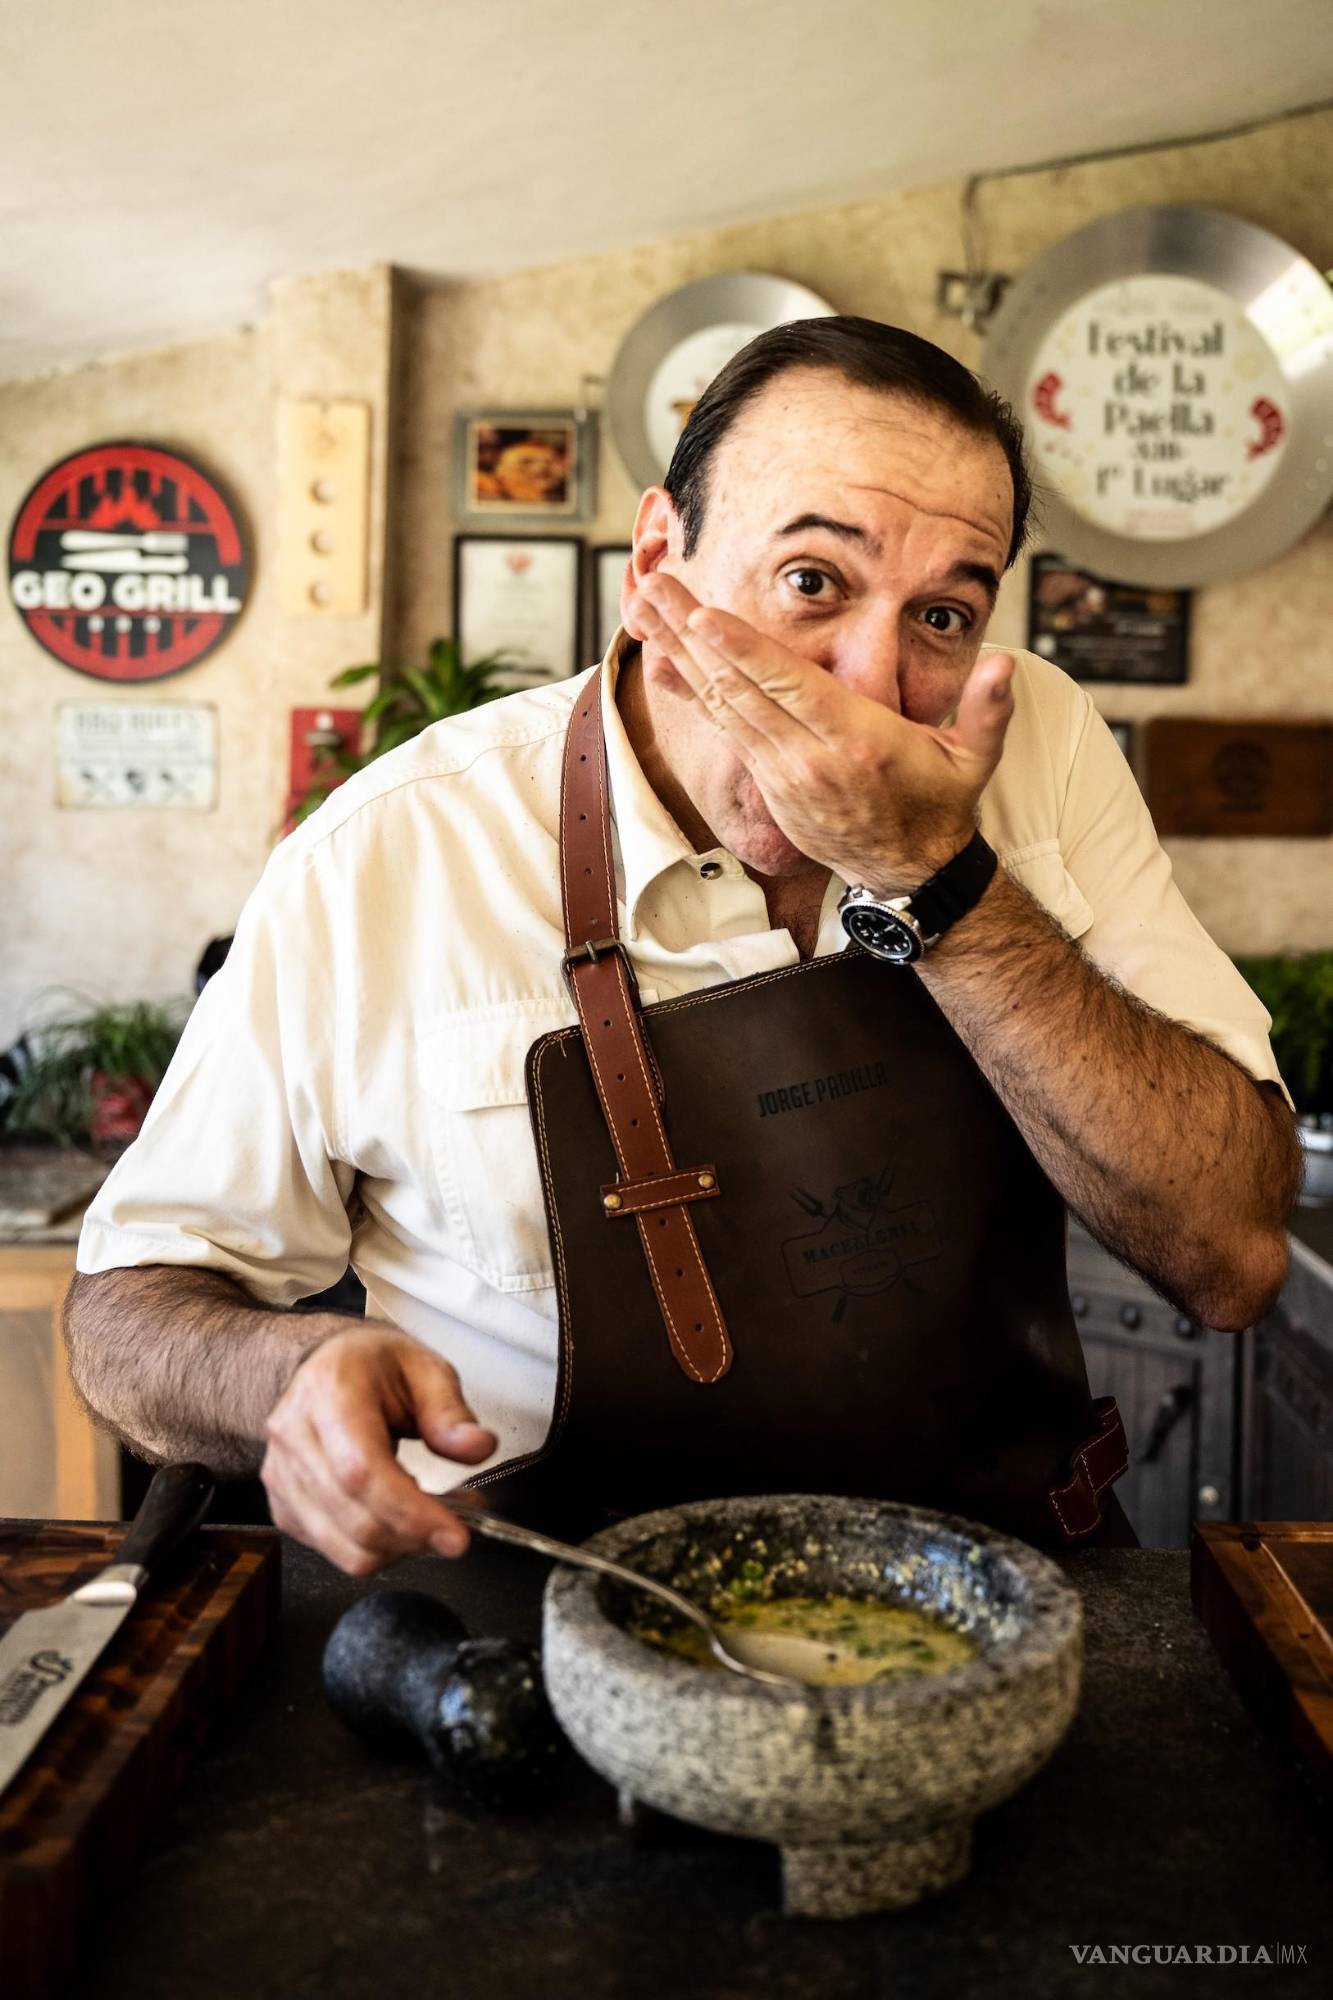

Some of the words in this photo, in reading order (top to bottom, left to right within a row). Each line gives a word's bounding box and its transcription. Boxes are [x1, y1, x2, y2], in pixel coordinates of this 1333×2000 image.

[1104, 400, 1215, 437] Paella
[12, 571, 106, 611] GEO
[112, 573, 241, 613] GRILL
[757, 1082, 814, 1118] JORGE
[815, 1061, 889, 1103] PADILLA
